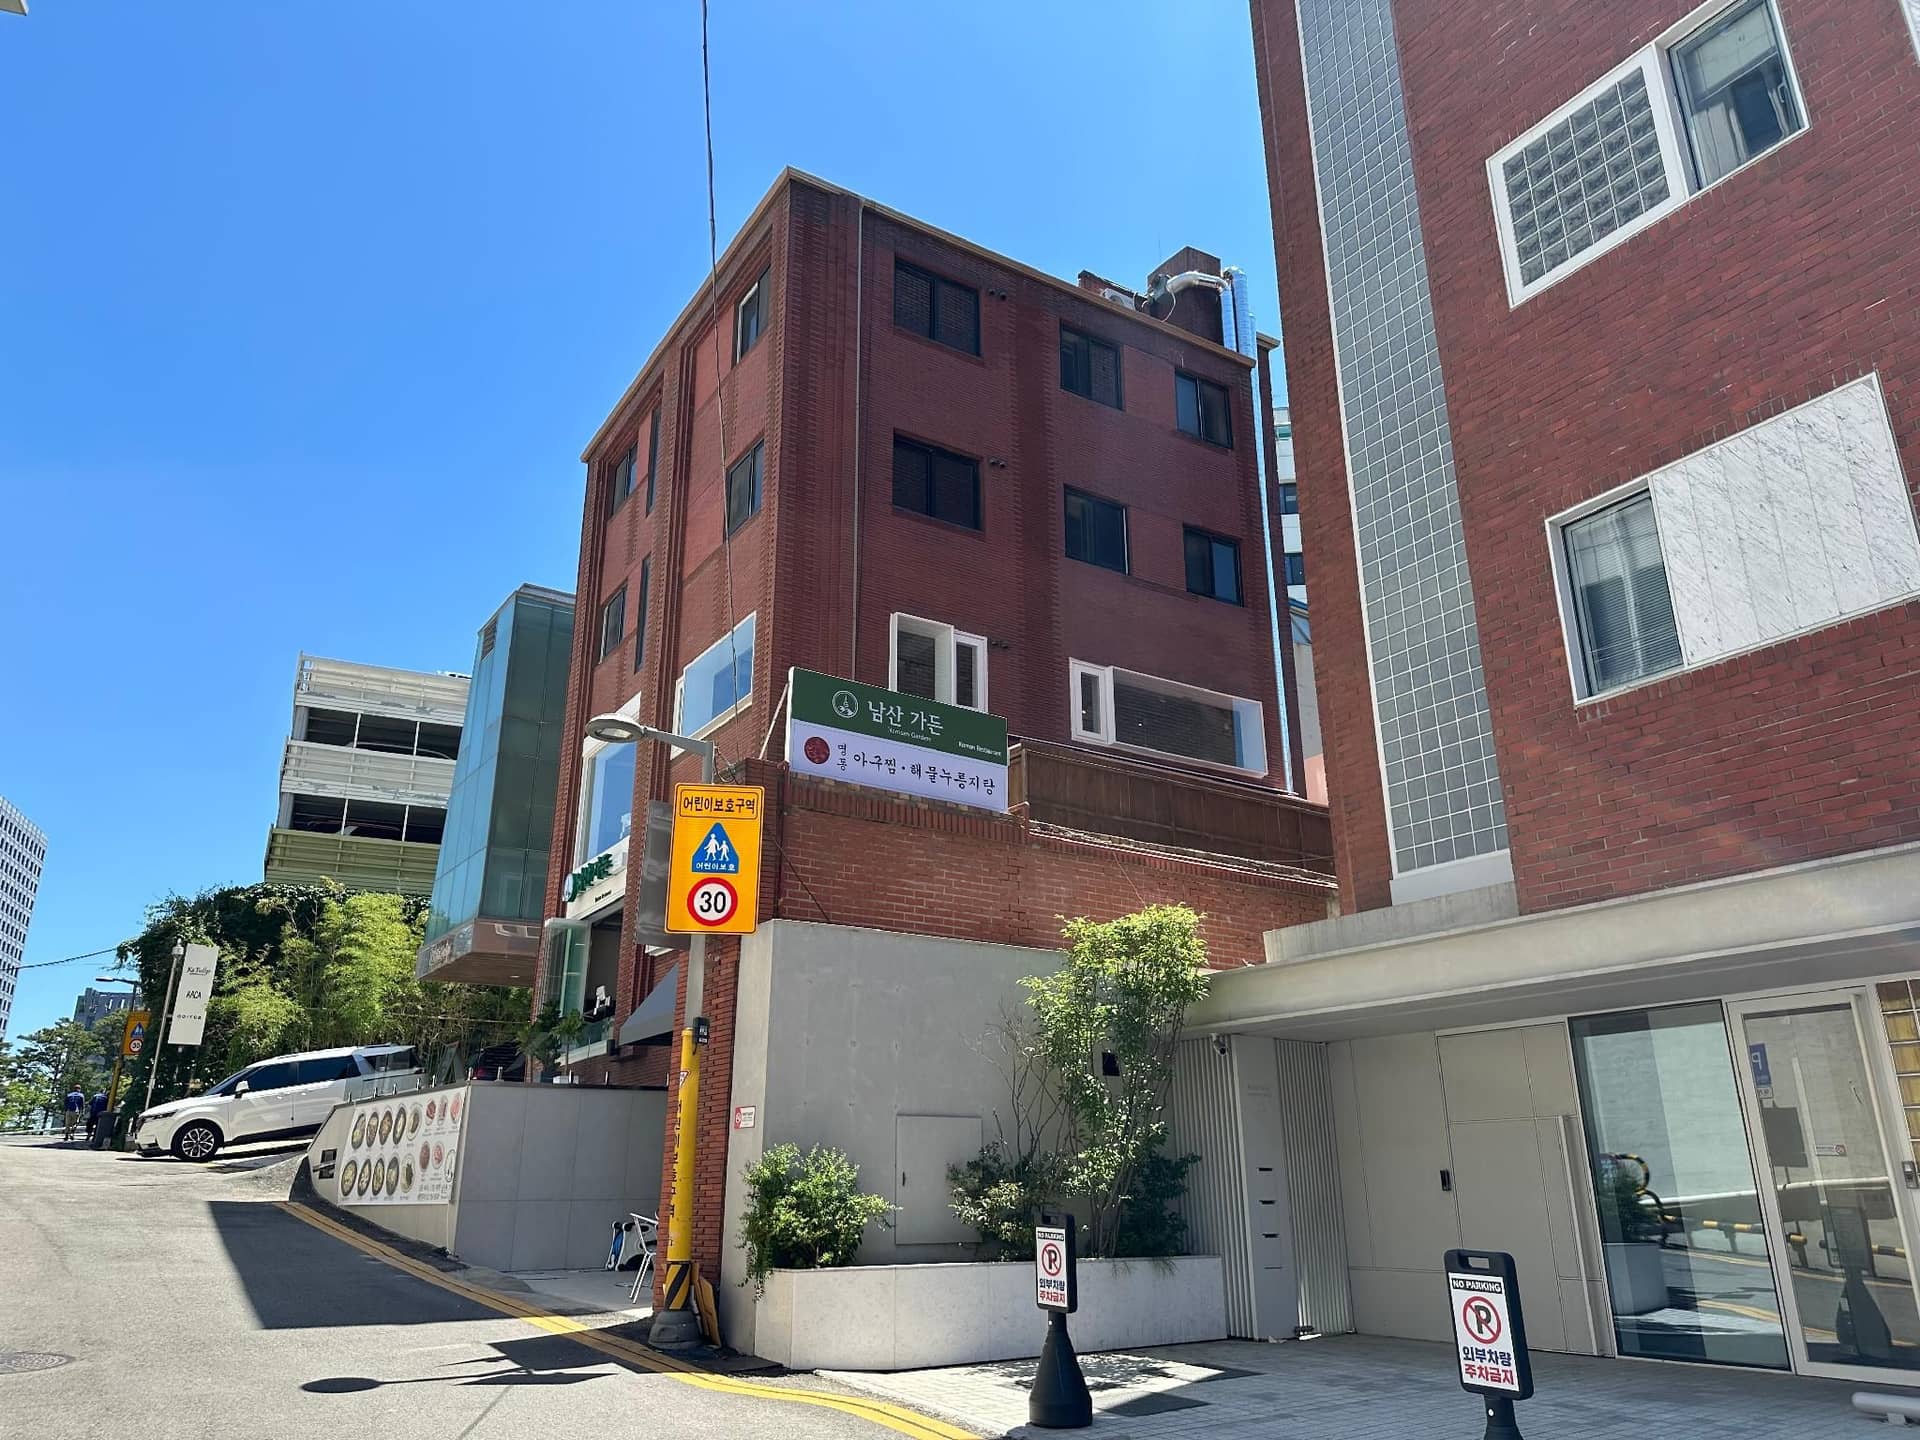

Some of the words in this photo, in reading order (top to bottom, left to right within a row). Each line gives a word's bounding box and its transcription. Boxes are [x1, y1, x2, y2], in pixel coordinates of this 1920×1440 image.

[867, 700, 904, 728] 남산
[910, 711, 944, 736] 가든
[683, 796, 755, 815] 어린이보호구역
[695, 861, 736, 872] 어린이보호
[699, 890, 727, 914] 30
[1045, 1232, 1064, 1241] PARKING
[1040, 1279, 1065, 1291] 외부차량
[1452, 1279, 1465, 1289] NO
[1466, 1280, 1502, 1293] PARKING
[1040, 1290, 1065, 1304] 주차금지
[1462, 1345, 1512, 1367] 외부차량
[1464, 1363, 1515, 1386] 주차금지
